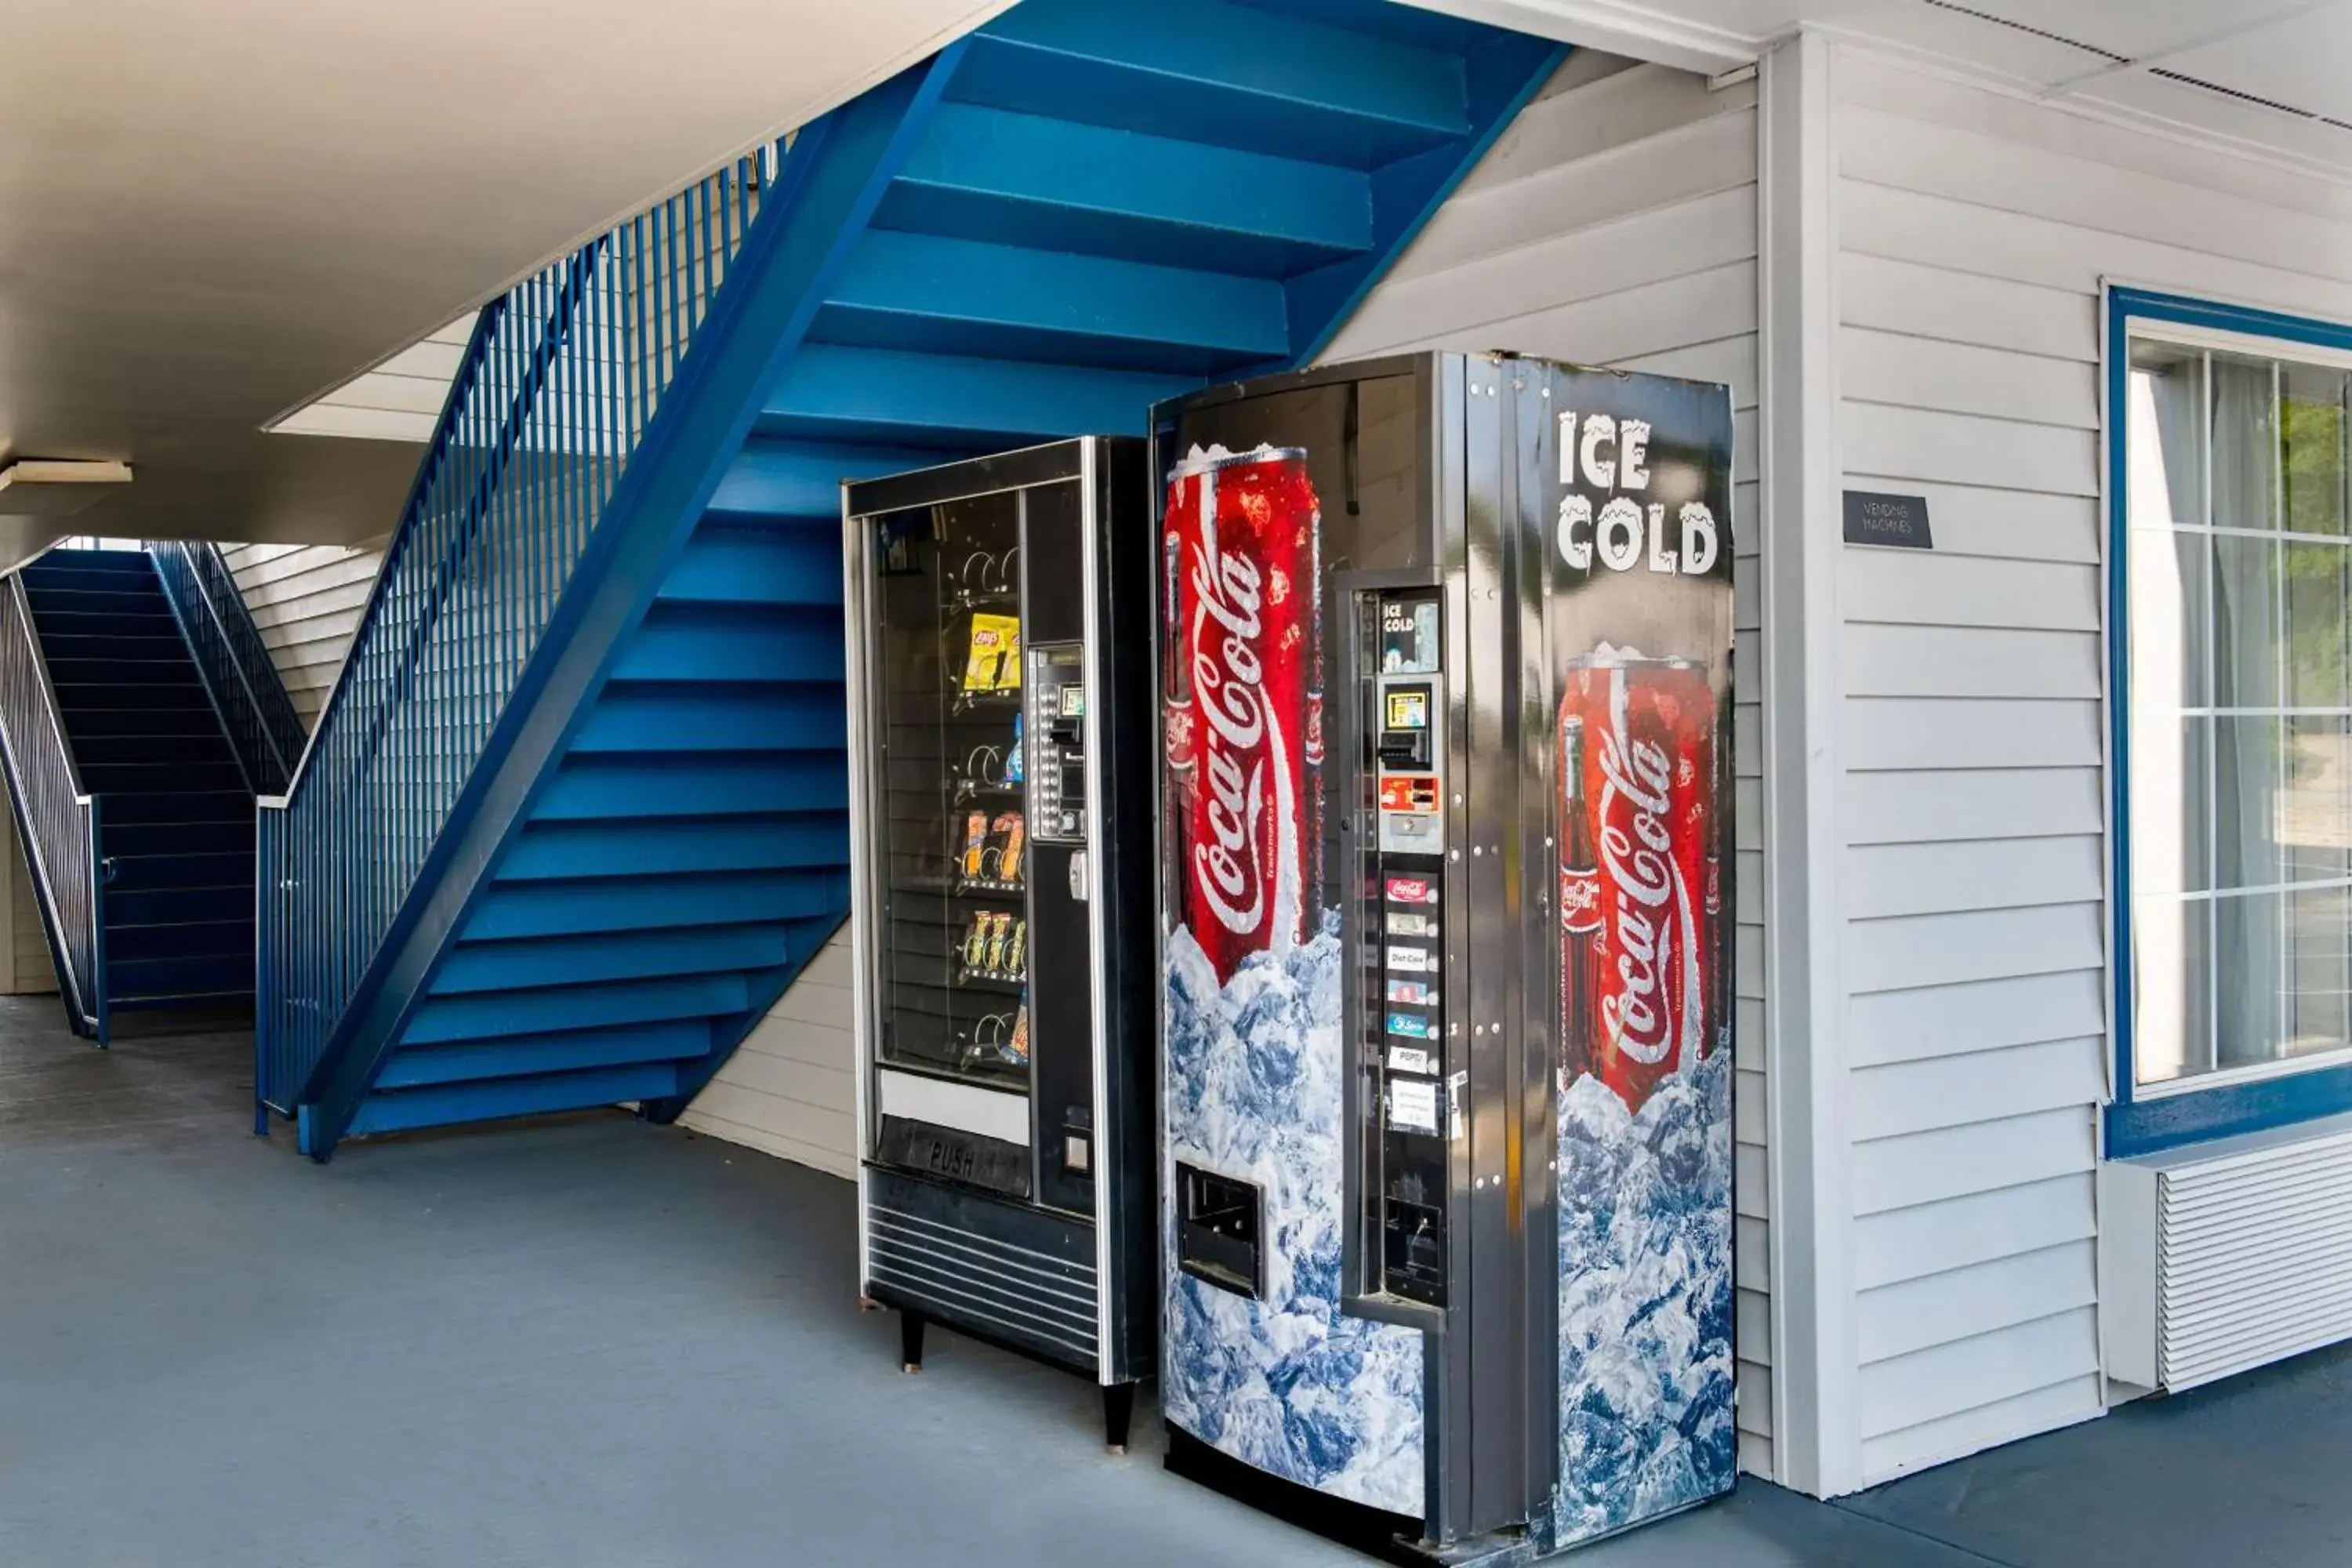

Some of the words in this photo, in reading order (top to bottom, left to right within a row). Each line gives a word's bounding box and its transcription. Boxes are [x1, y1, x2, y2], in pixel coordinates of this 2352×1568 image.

[1559, 411, 1651, 496] ICE
[1557, 494, 1718, 578] COLD
[1862, 502, 1907, 518] VENDING
[1385, 604, 1401, 617] ICE
[1385, 619, 1414, 632] COLD
[1192, 541, 1263, 934] Coca-Cola
[1598, 727, 1671, 1064] Coca-Cola
[931, 1142, 975, 1176] PUSH
